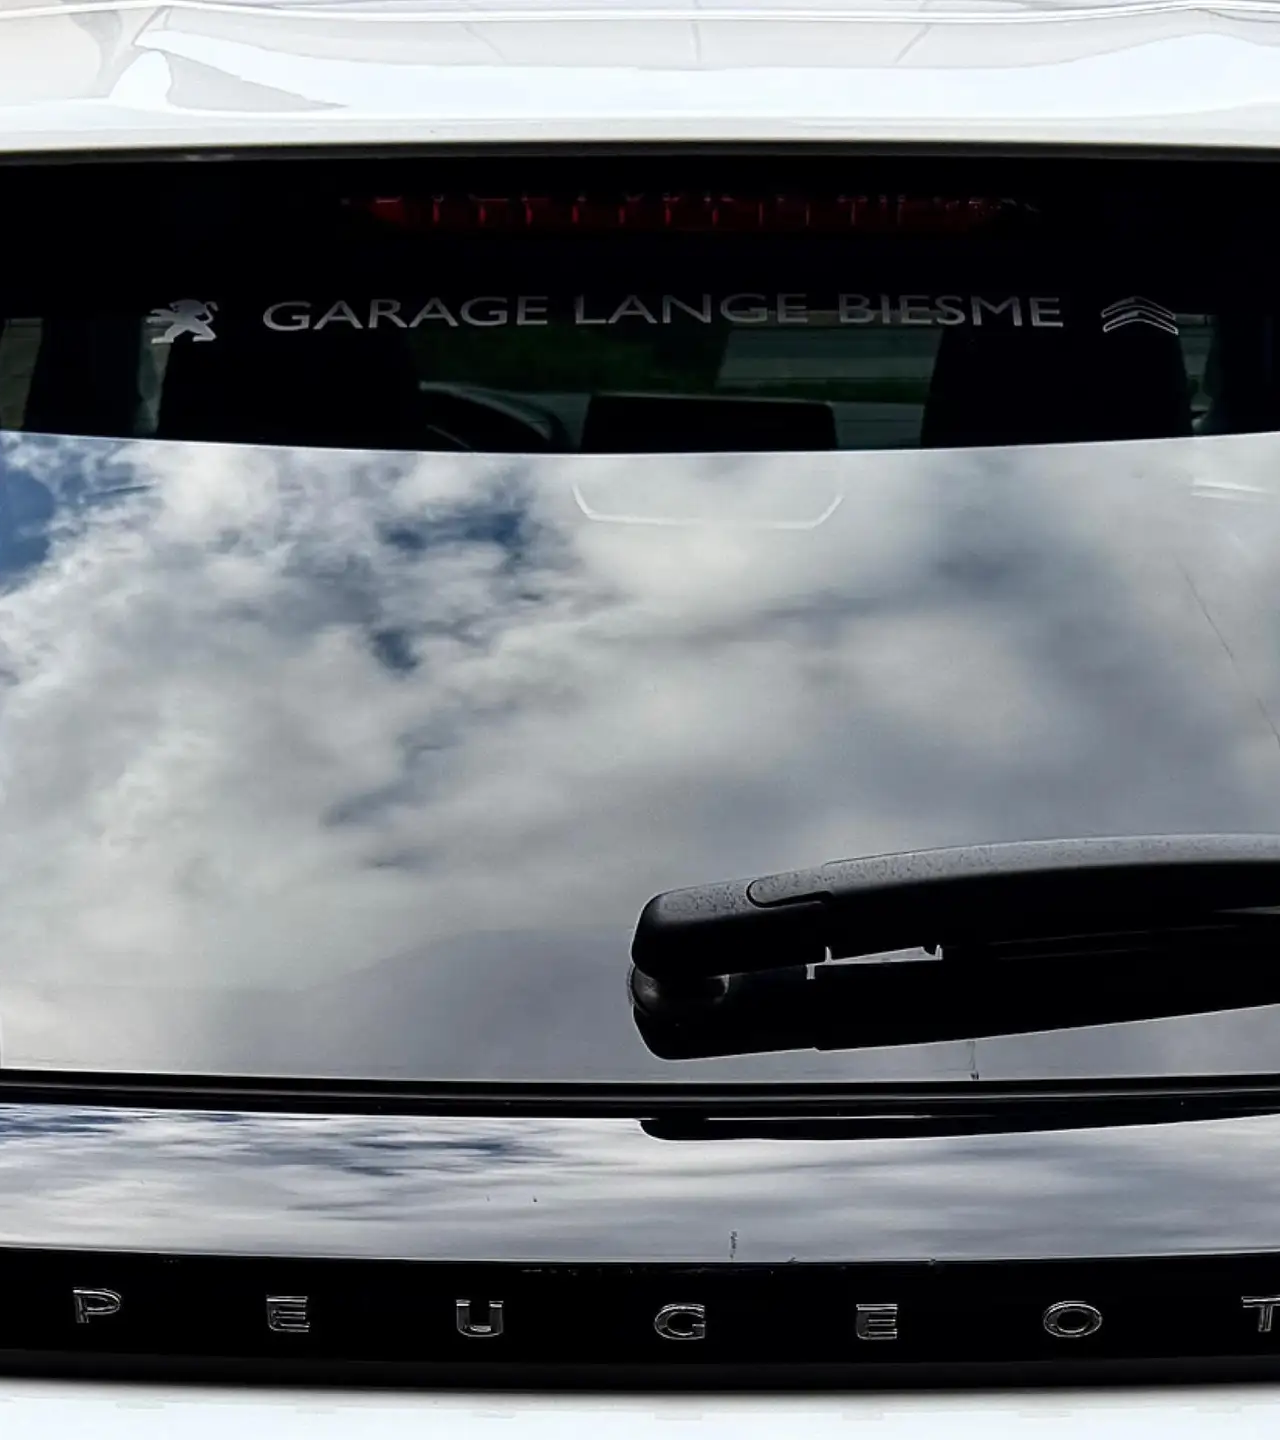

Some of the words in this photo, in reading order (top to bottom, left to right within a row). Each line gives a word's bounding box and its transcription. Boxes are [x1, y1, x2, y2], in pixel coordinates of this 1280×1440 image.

[262, 296, 549, 331] GARAGE
[575, 293, 809, 324] LANGE
[839, 294, 1064, 327] BIESME
